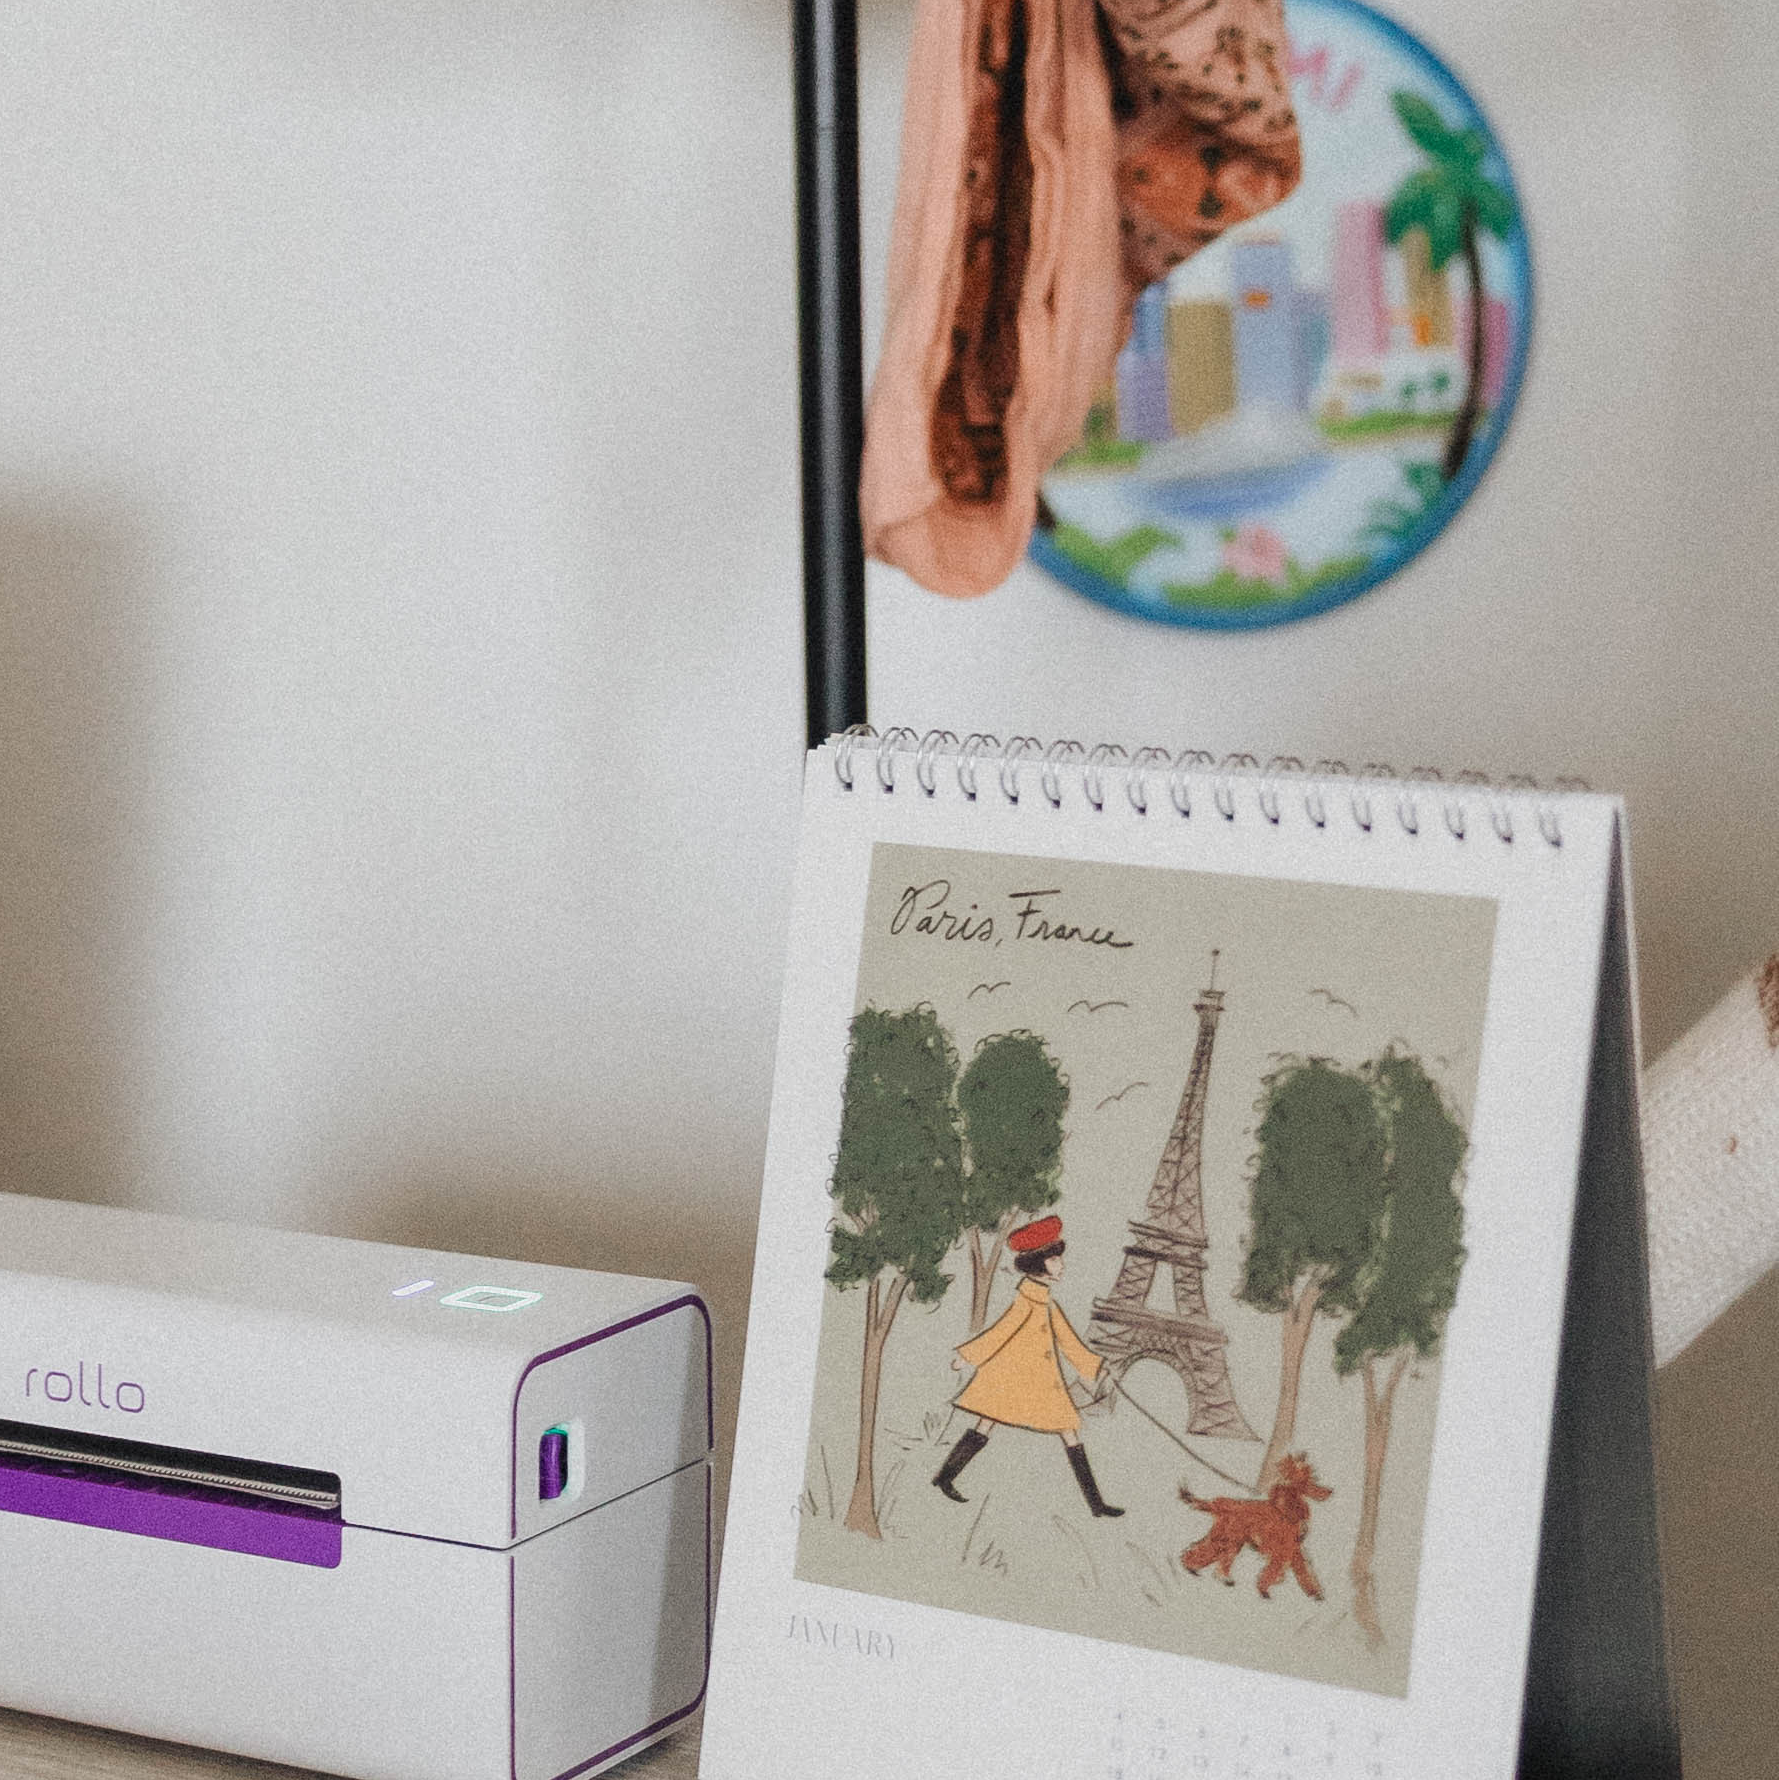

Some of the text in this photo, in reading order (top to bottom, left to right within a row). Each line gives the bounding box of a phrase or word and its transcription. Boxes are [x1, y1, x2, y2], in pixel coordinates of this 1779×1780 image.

[890, 879, 1134, 949] Paris, France
[26, 1361, 145, 1413] rollo
